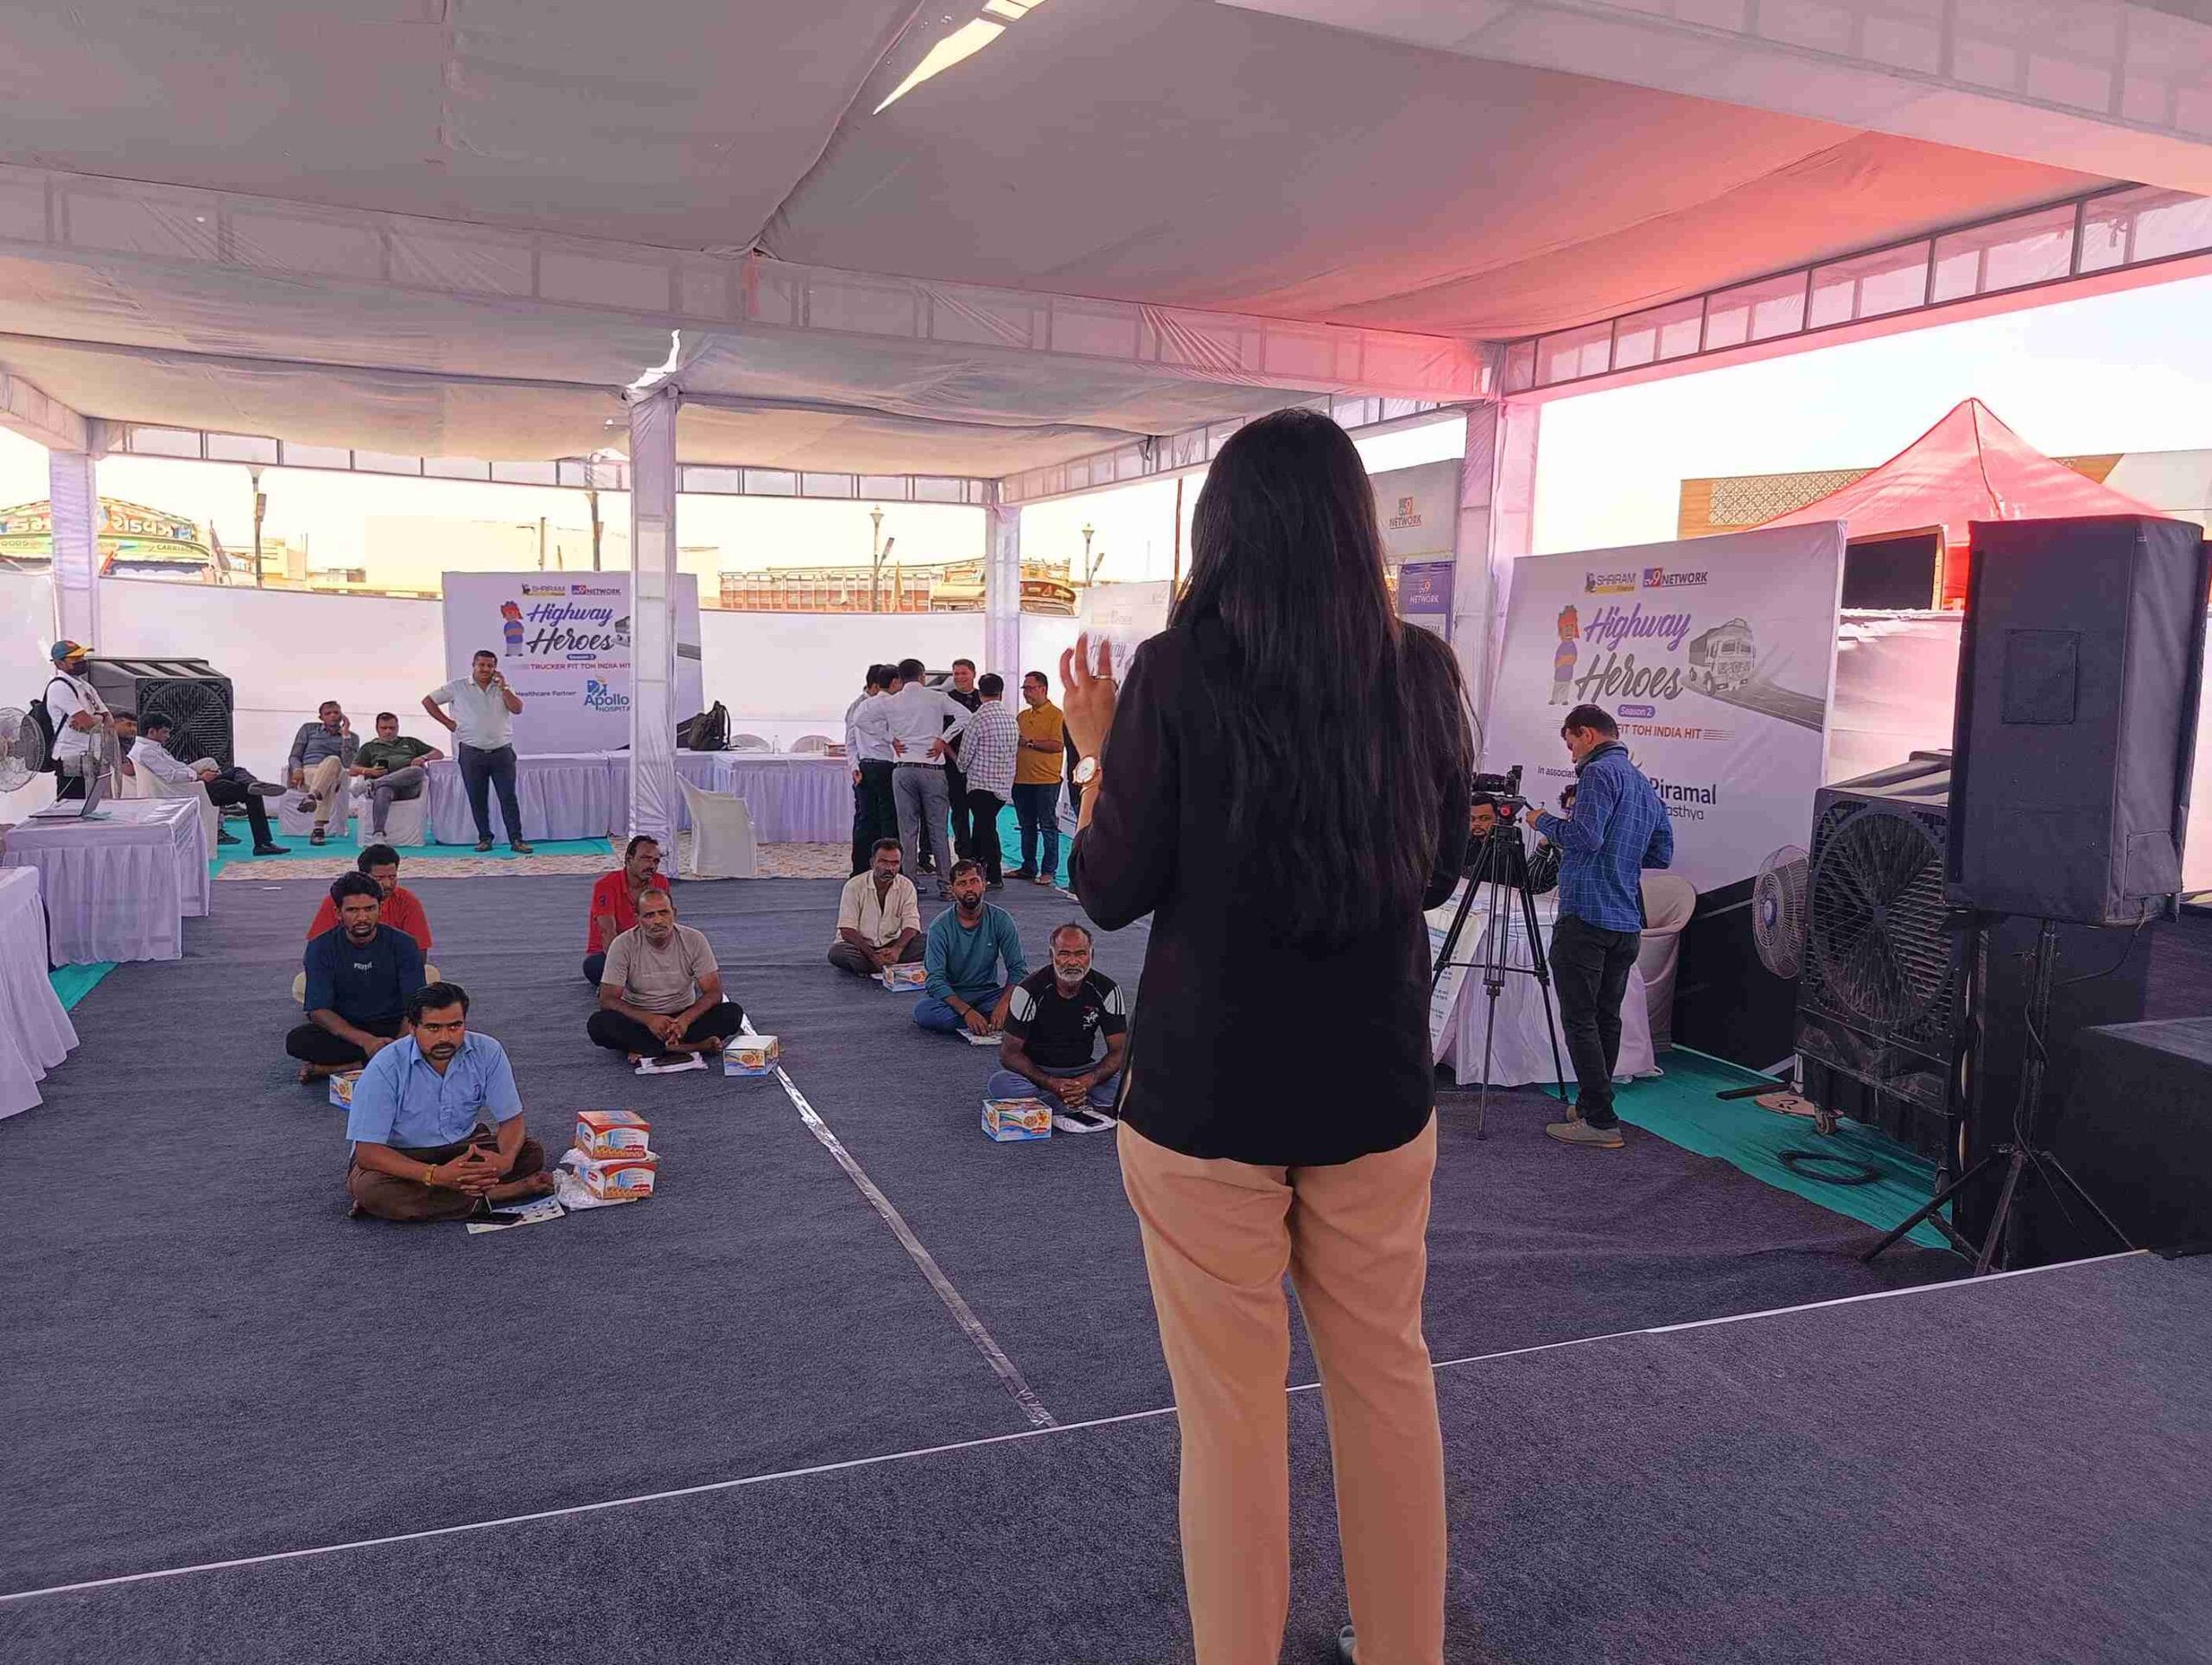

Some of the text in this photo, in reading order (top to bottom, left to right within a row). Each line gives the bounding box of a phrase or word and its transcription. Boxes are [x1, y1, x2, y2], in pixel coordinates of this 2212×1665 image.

[1662, 571, 1707, 585] NETWORK
[526, 602, 613, 627] Highway
[1584, 603, 1691, 651] Highway
[526, 627, 614, 654] Heroes
[1574, 652, 1683, 703] Heroes
[584, 694, 630, 710] Apollo
[1646, 707, 1653, 716] 2
[1632, 724, 1652, 736] TOH
[1654, 726, 1681, 738] INDIA
[1684, 728, 1702, 740] HIT
[1537, 766, 1545, 774] In
[1649, 778, 1717, 805] Piramal
[1665, 804, 1704, 821] asthya
